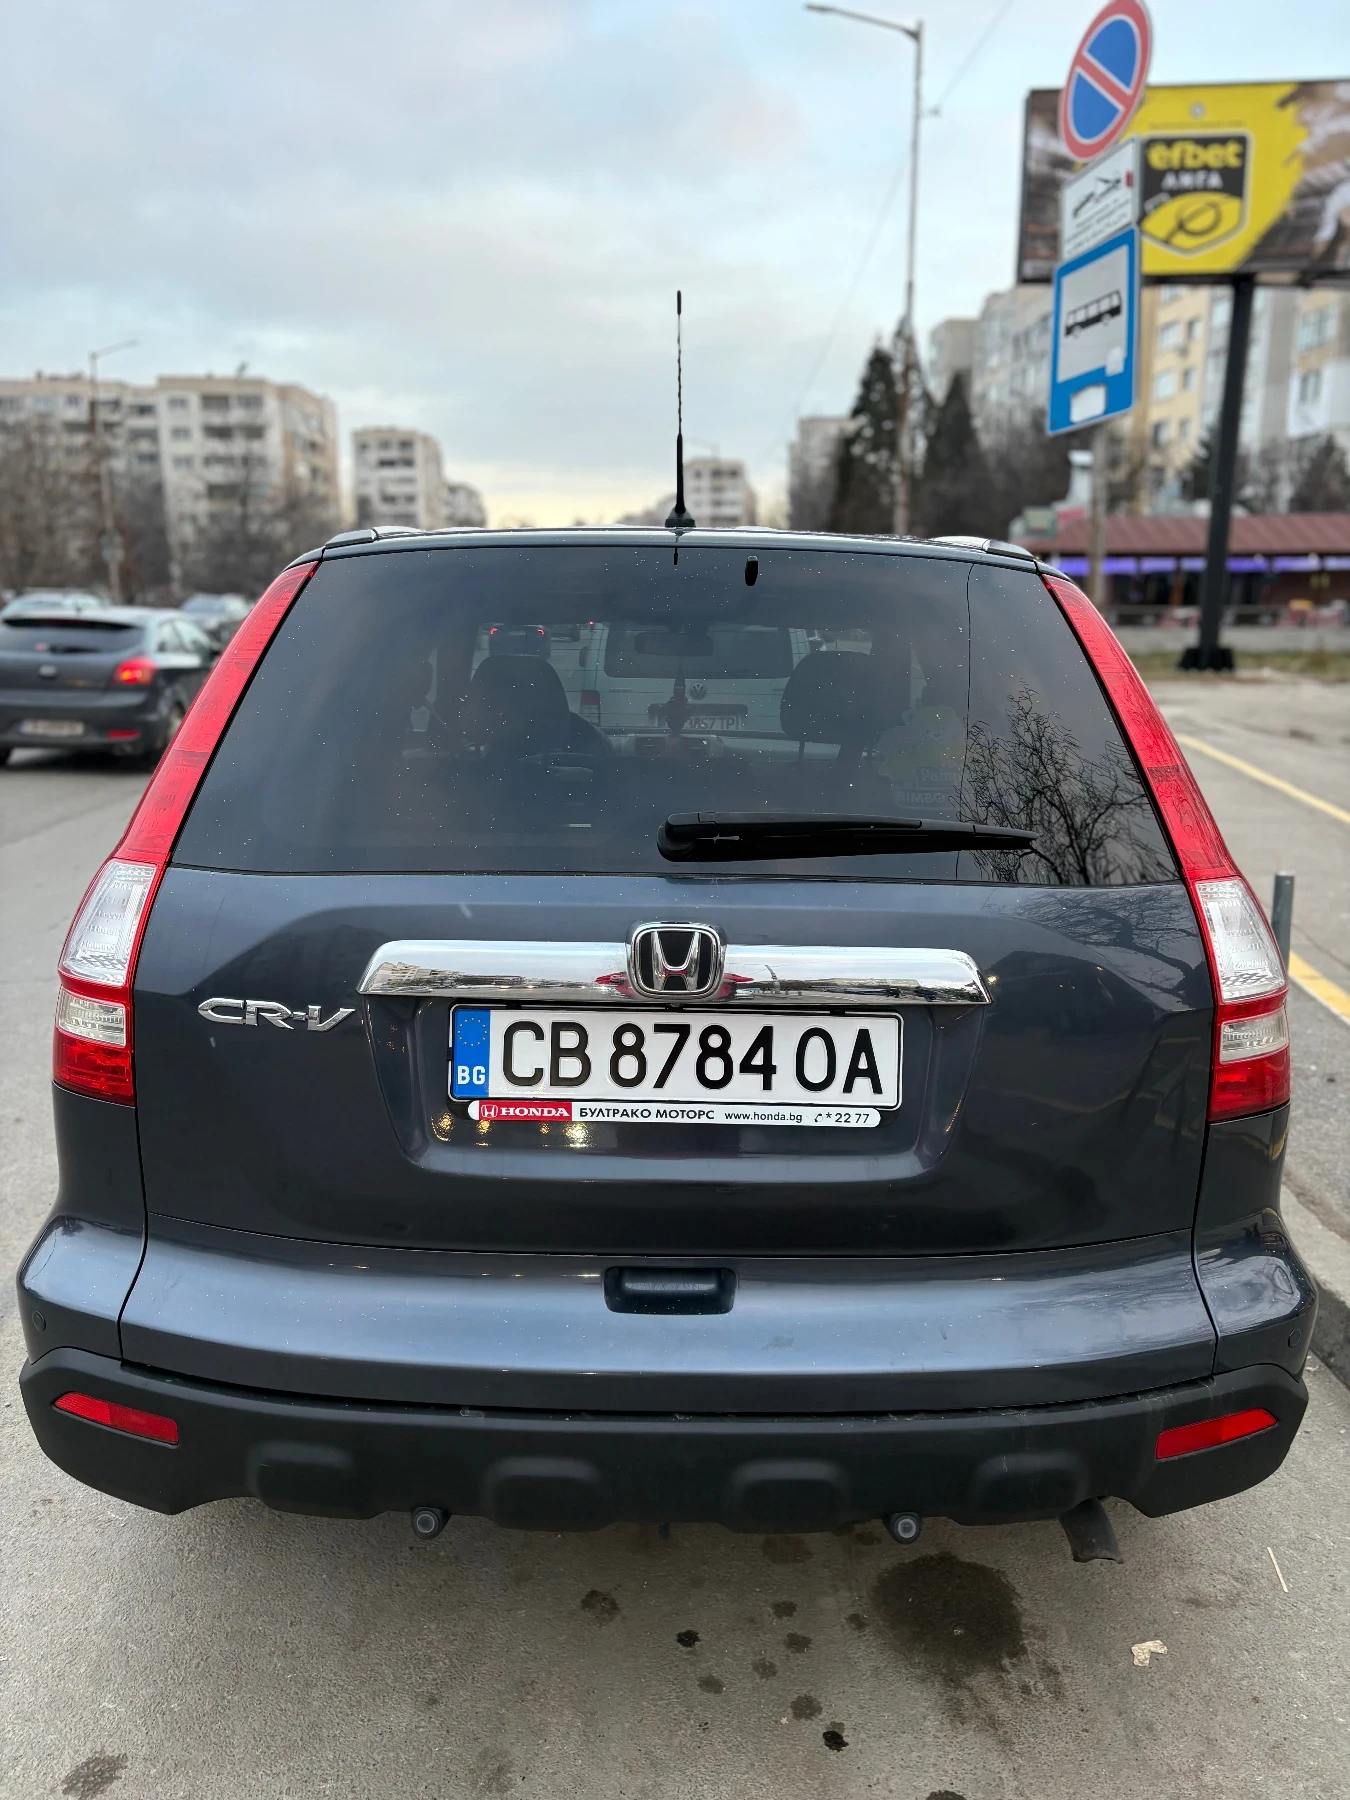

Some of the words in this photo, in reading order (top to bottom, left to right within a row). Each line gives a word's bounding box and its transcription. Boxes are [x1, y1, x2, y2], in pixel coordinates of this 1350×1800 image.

[1147, 140, 1243, 169] efbet
[198, 997, 356, 1032] CR-V
[502, 1020, 592, 1087] CB
[609, 1022, 777, 1090] 8784
[457, 1065, 486, 1085] BG
[500, 1107, 571, 1117] HONDA
[579, 1107, 652, 1119] БУЛТРАКО
[655, 1109, 716, 1120] МОТОРС
[724, 1111, 803, 1123] www.honda.bg
